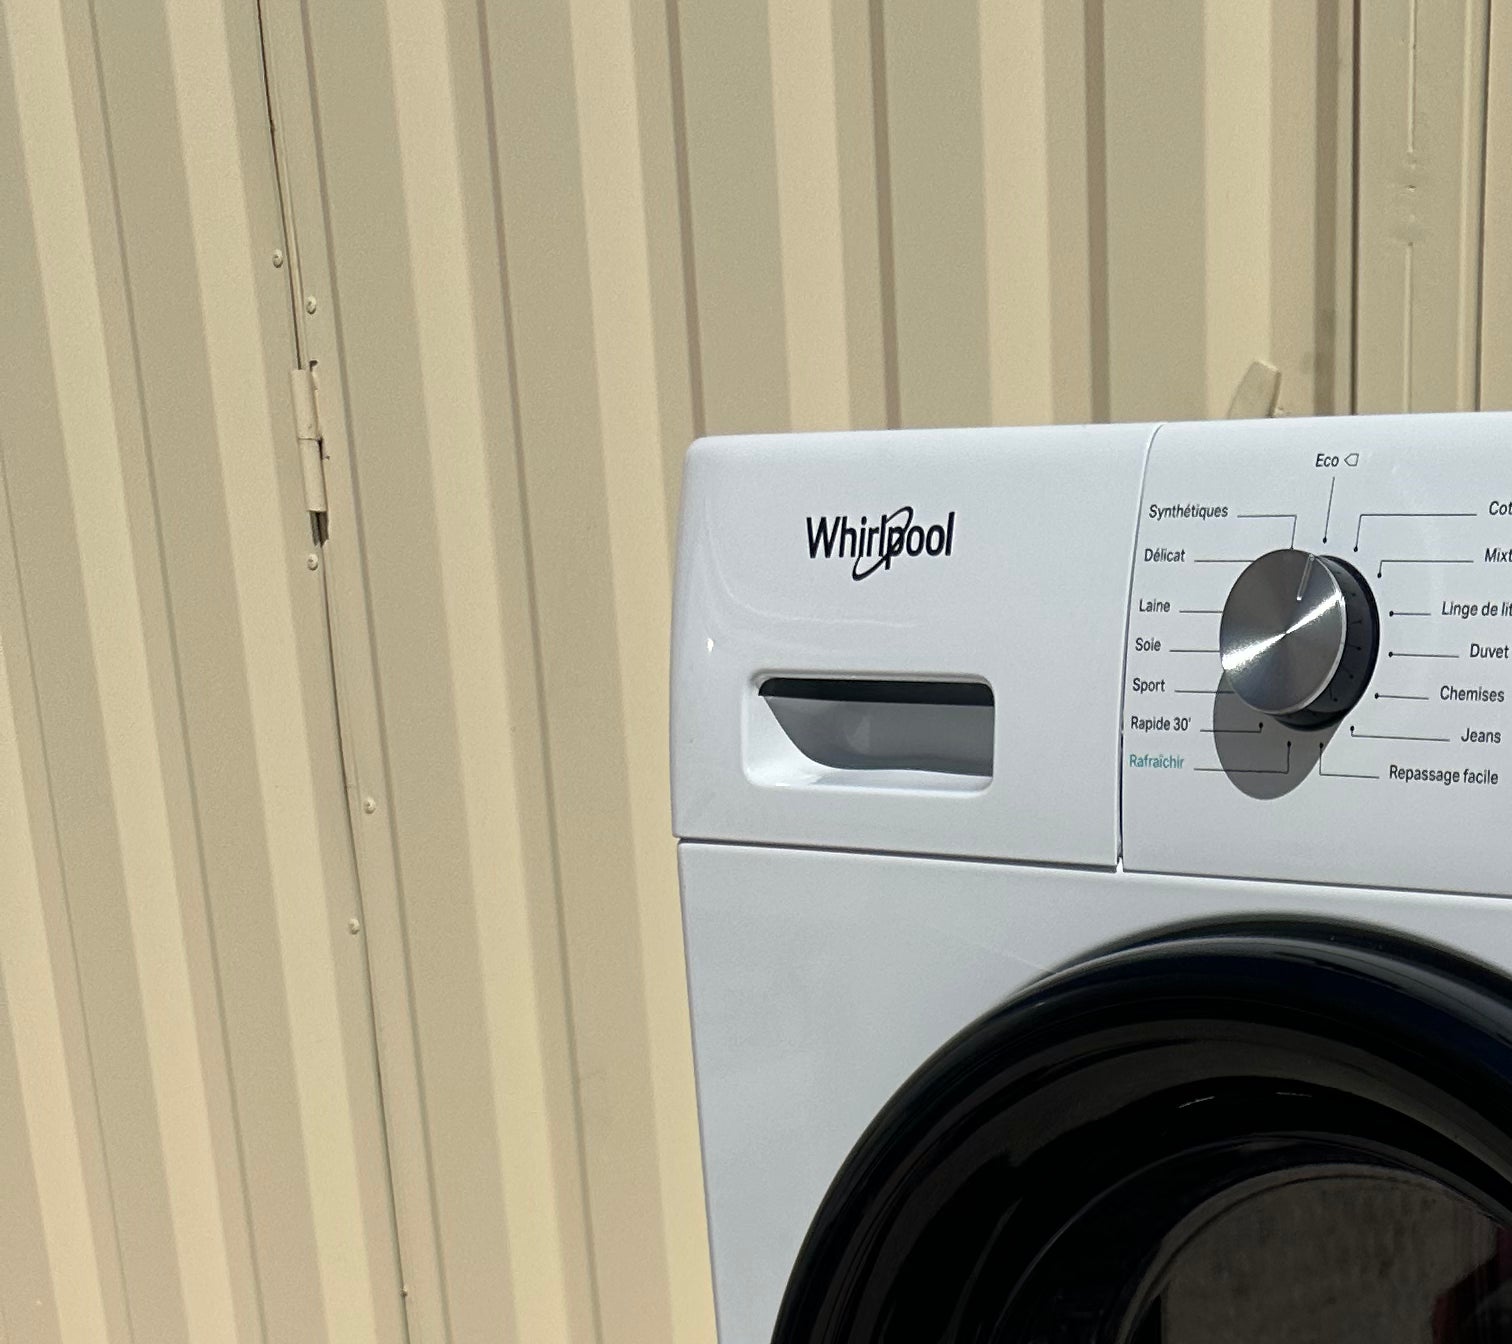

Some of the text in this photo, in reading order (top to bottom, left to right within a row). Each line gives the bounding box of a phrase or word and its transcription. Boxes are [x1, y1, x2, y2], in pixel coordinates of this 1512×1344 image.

[1316, 454, 1339, 467] Eco
[1149, 504, 1228, 521] Synthétiques
[806, 506, 955, 581] Whirlpool
[1144, 548, 1185, 562] Délicat
[1139, 599, 1170, 612] Laine
[1442, 601, 1478, 619] Linge
[1482, 602, 1498, 616] de
[1135, 638, 1161, 651] Soie
[1470, 644, 1509, 658] Duvet
[1133, 678, 1165, 694] Sport
[1440, 686, 1504, 702] Chemises
[1131, 716, 1191, 732] Rapide 30'
[1461, 728, 1501, 743] Jeans
[1129, 754, 1185, 769] Rafraîchir
[1390, 765, 1498, 785] Repassage facile
